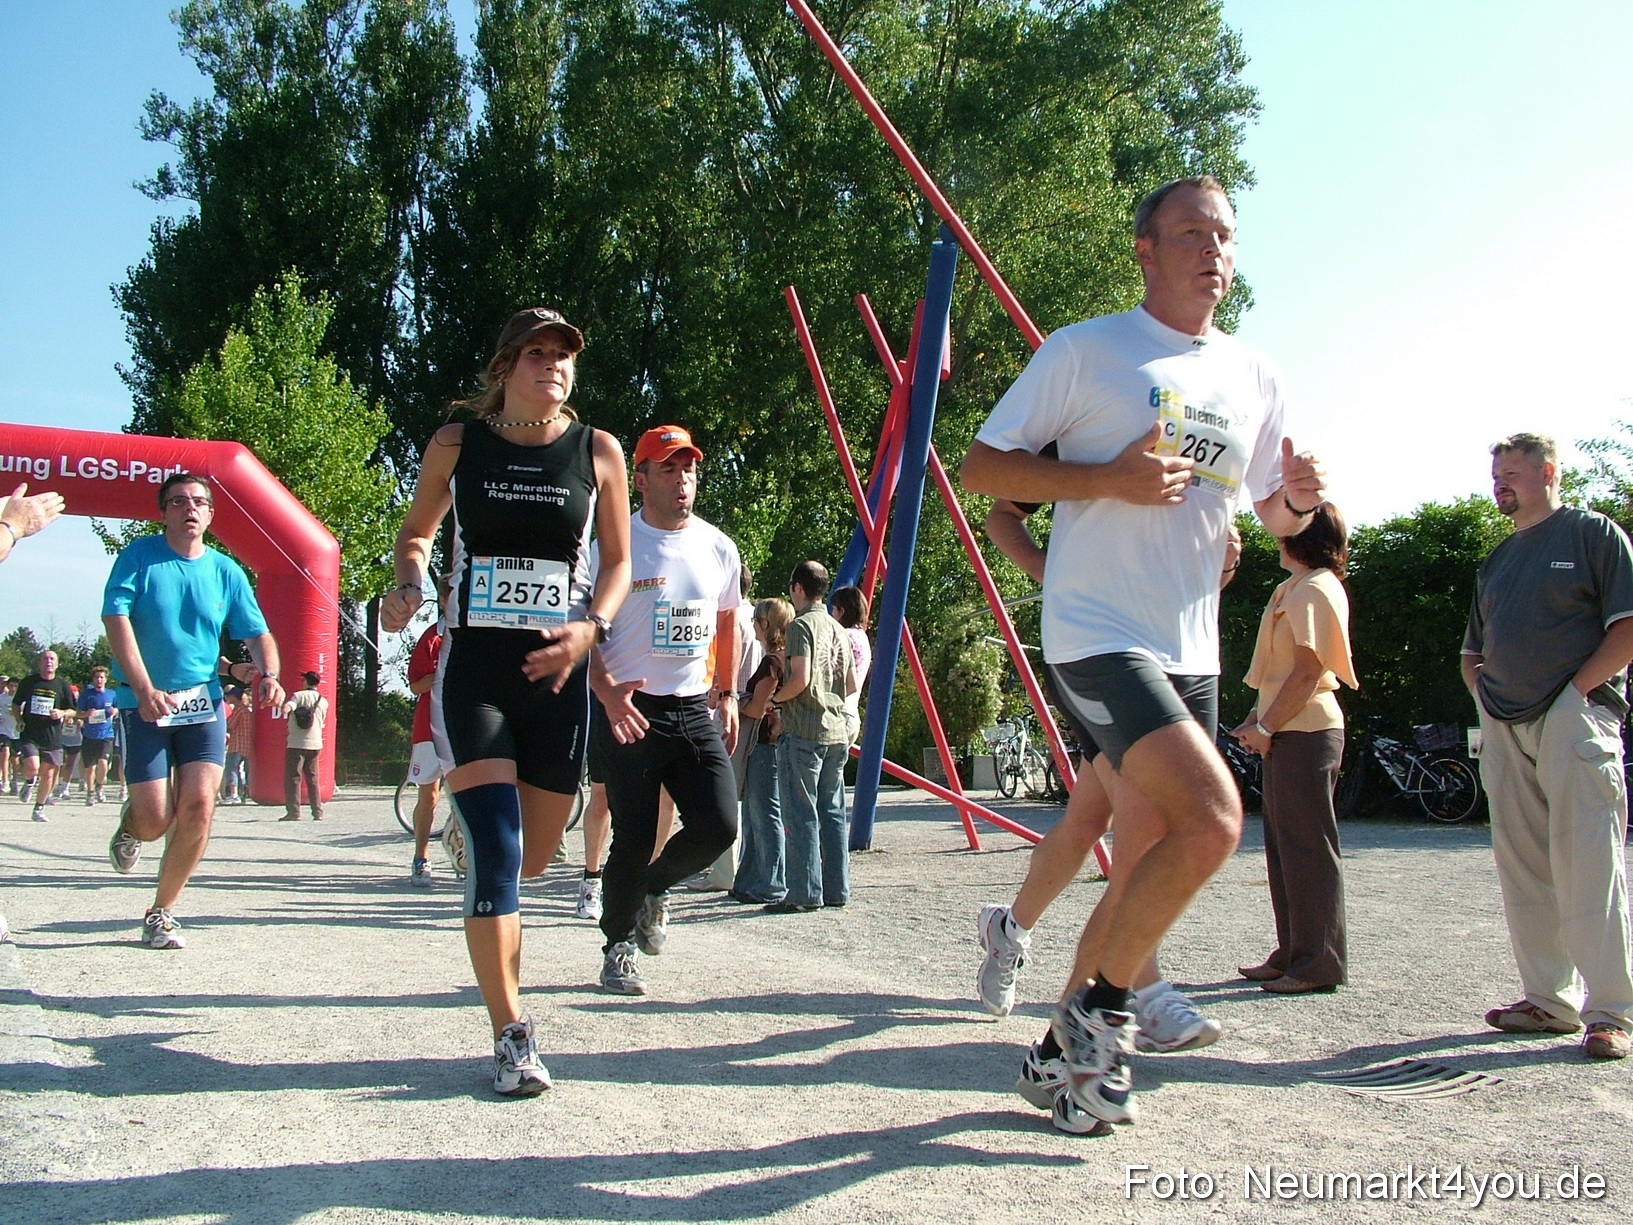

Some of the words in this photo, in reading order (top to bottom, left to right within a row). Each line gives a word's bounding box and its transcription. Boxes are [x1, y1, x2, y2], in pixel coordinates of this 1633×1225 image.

[1165, 422, 1175, 436] C
[1180, 433, 1227, 467] 267
[484, 481, 509, 490] LLC
[512, 483, 570, 496] Marathon
[488, 490, 565, 506] Regensburg
[496, 558, 534, 571] anika
[475, 576, 486, 588] A
[633, 577, 666, 589] MERZ
[496, 581, 561, 607] 2573
[671, 606, 701, 618] Ludwig
[657, 621, 665, 631] B
[672, 624, 709, 642] 2894
